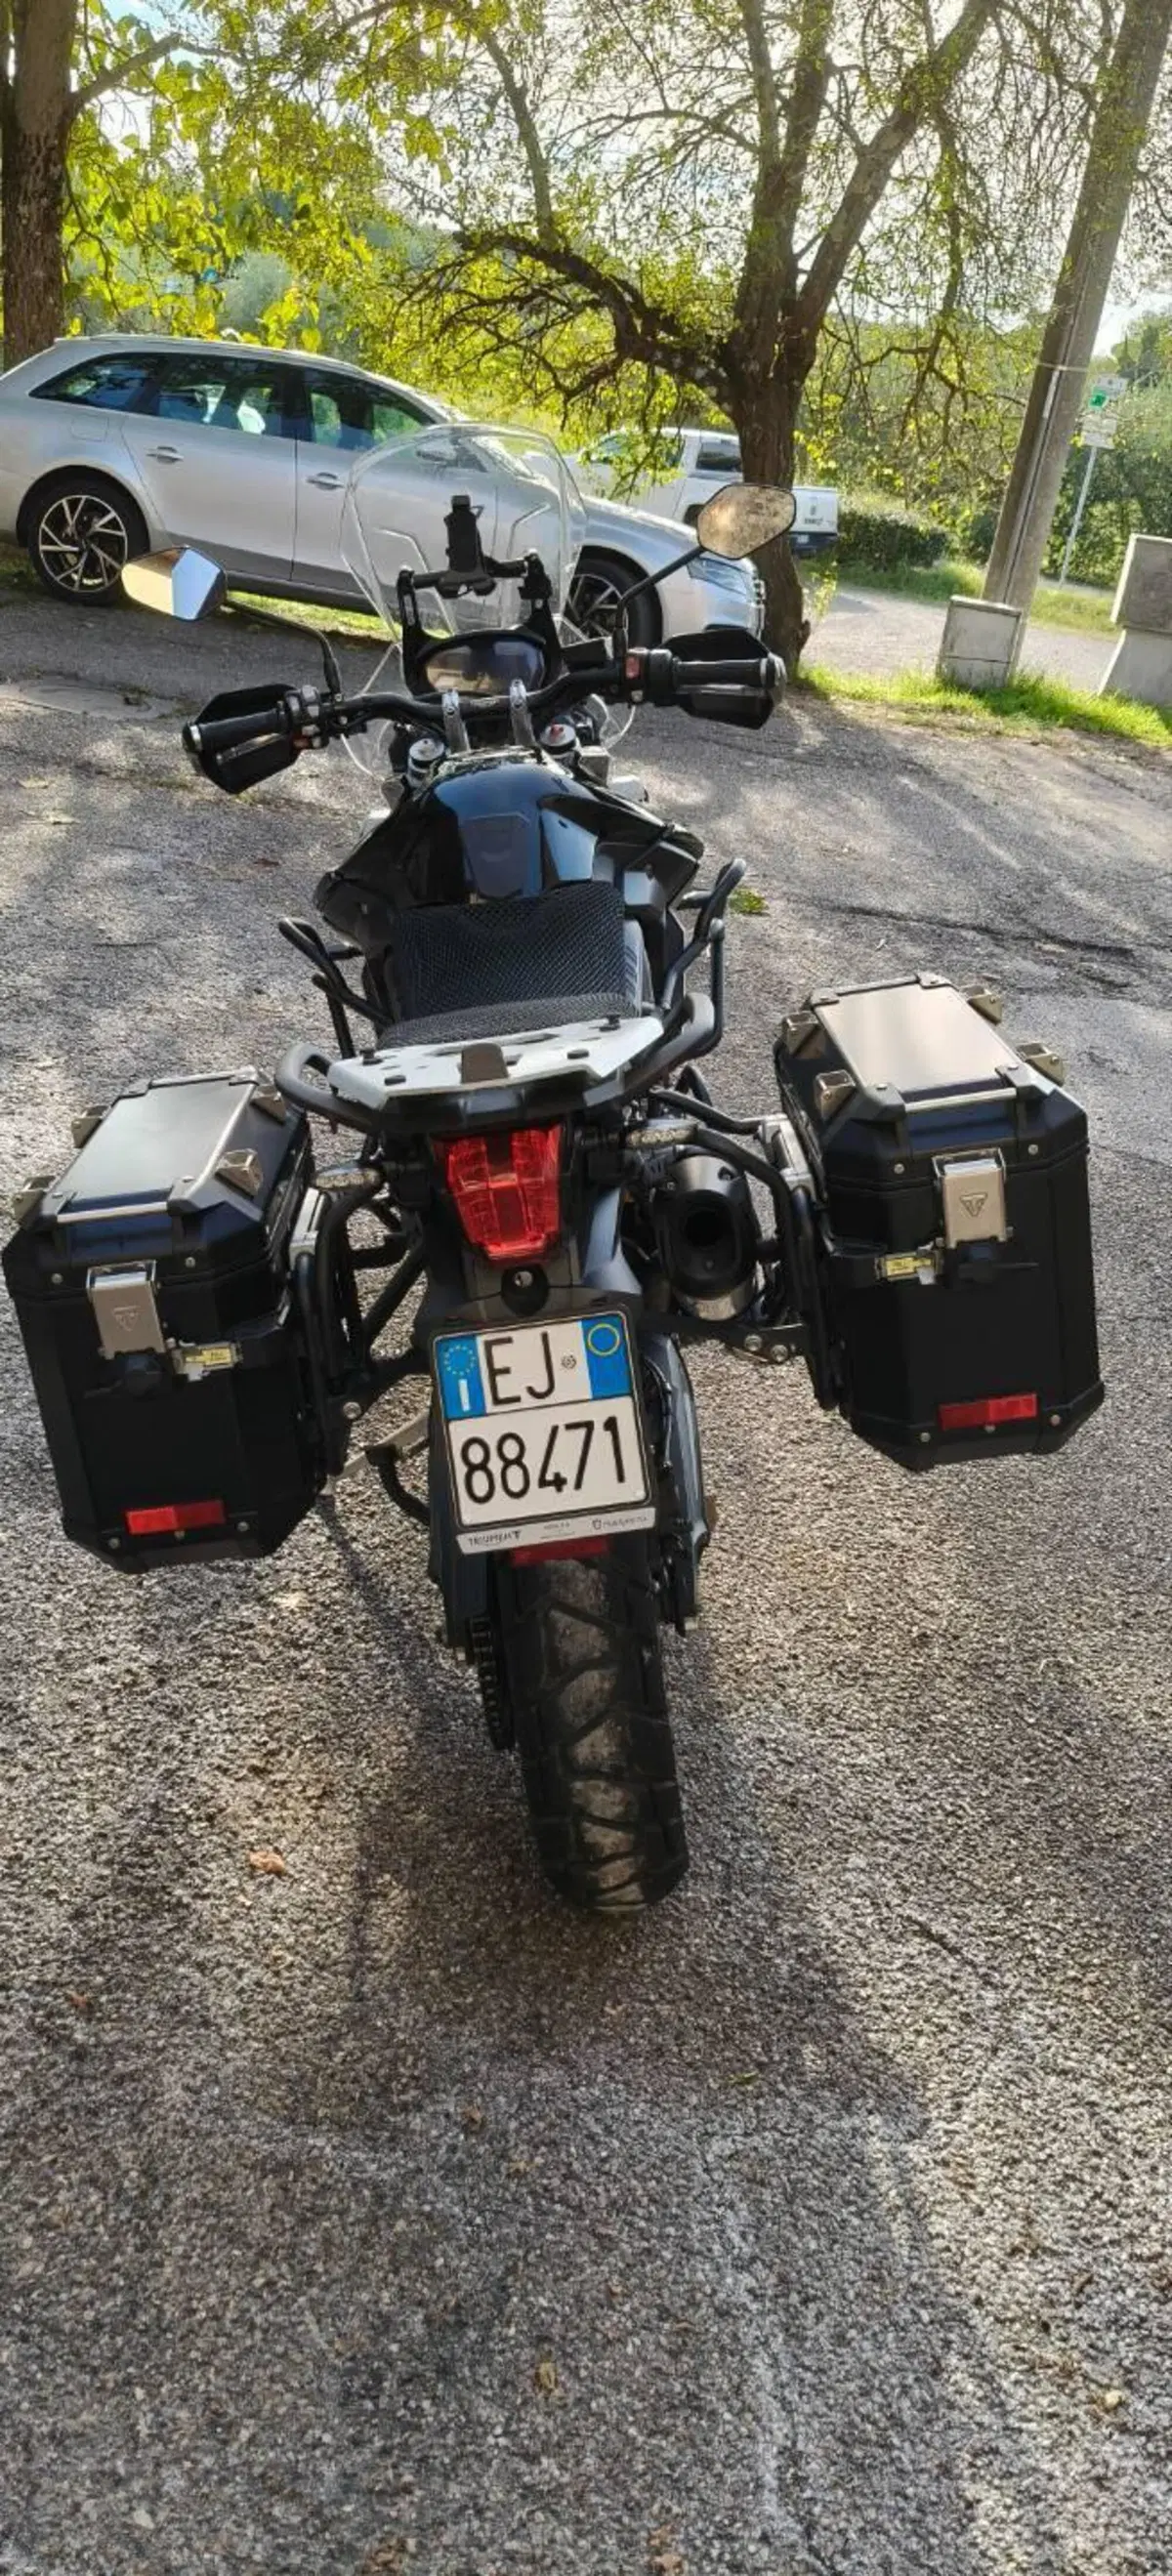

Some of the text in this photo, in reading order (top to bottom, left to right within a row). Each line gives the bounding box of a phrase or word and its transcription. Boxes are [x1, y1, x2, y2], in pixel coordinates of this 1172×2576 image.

[458, 1379, 470, 1412] I
[484, 1331, 555, 1405] EJ
[461, 1416, 625, 1504] 88471
